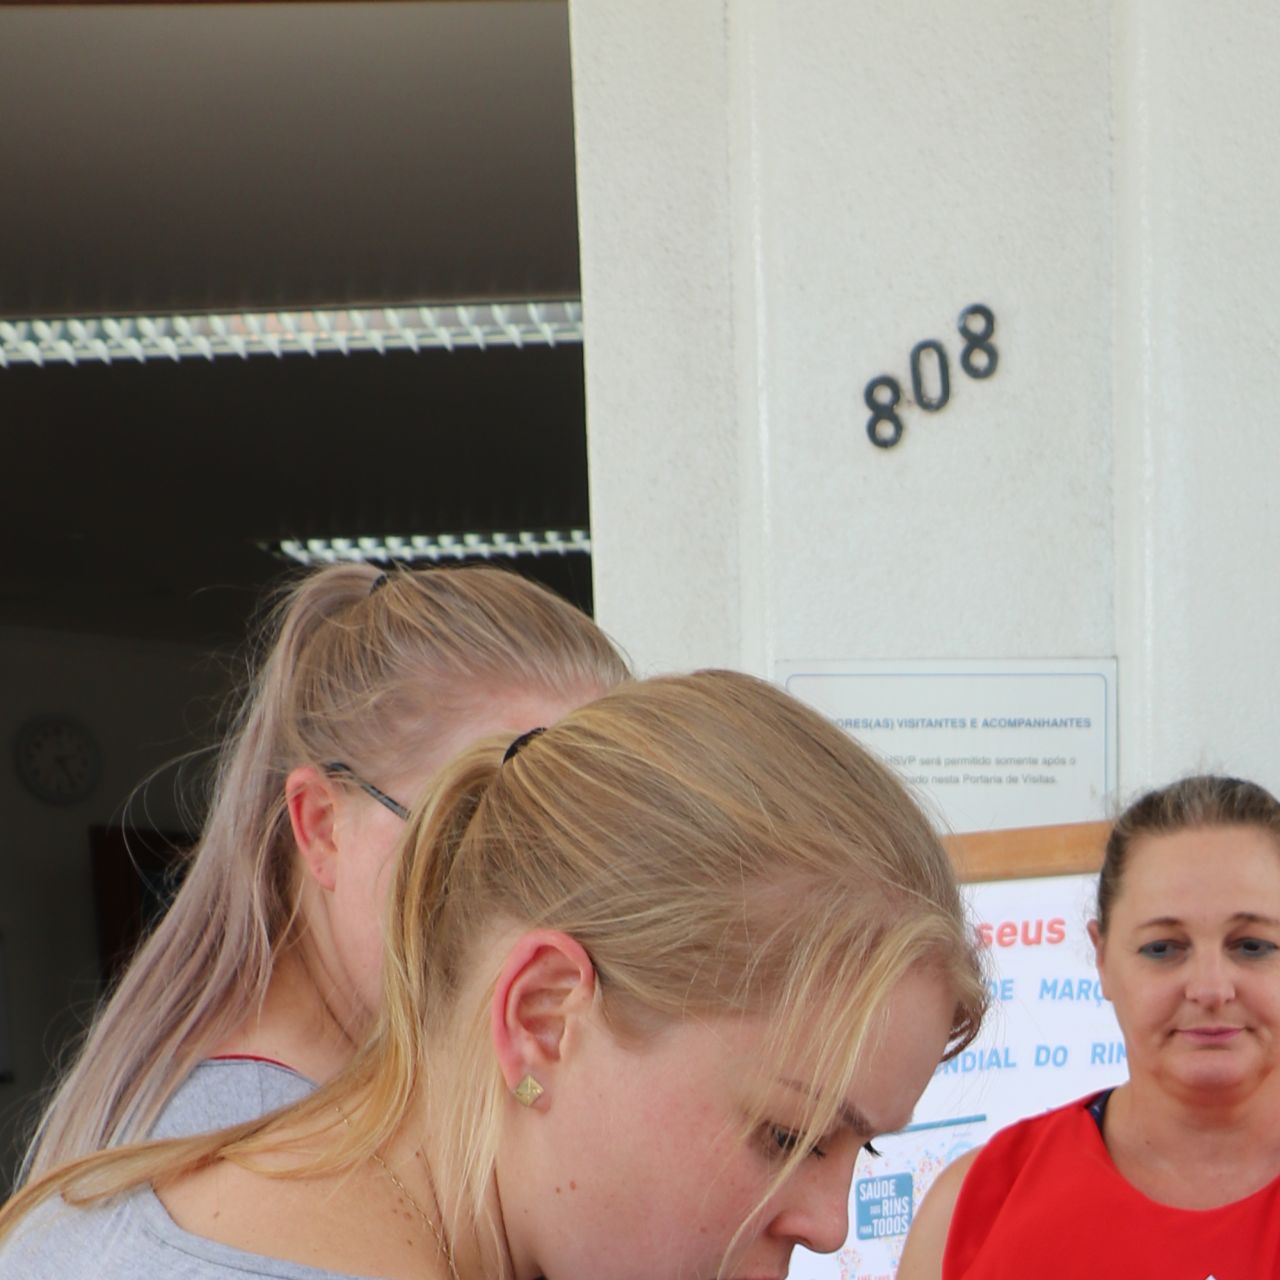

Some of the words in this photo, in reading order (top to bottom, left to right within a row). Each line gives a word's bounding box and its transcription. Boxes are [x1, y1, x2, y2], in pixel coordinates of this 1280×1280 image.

[863, 303, 999, 449] 808
[832, 718, 894, 730] ORES(AS)
[898, 717, 966, 729] VISITANTES
[970, 717, 977, 728] E
[981, 717, 1091, 728] ACOMPANHANTES
[976, 917, 1067, 949] seus
[1038, 978, 1104, 1007] MARÇ
[936, 1047, 1016, 1075] NDIAL
[1034, 1045, 1068, 1067] DO
[858, 1178, 896, 1201] SAÚDE
[882, 1196, 909, 1216] RINS
[872, 1215, 909, 1236] TODOS
